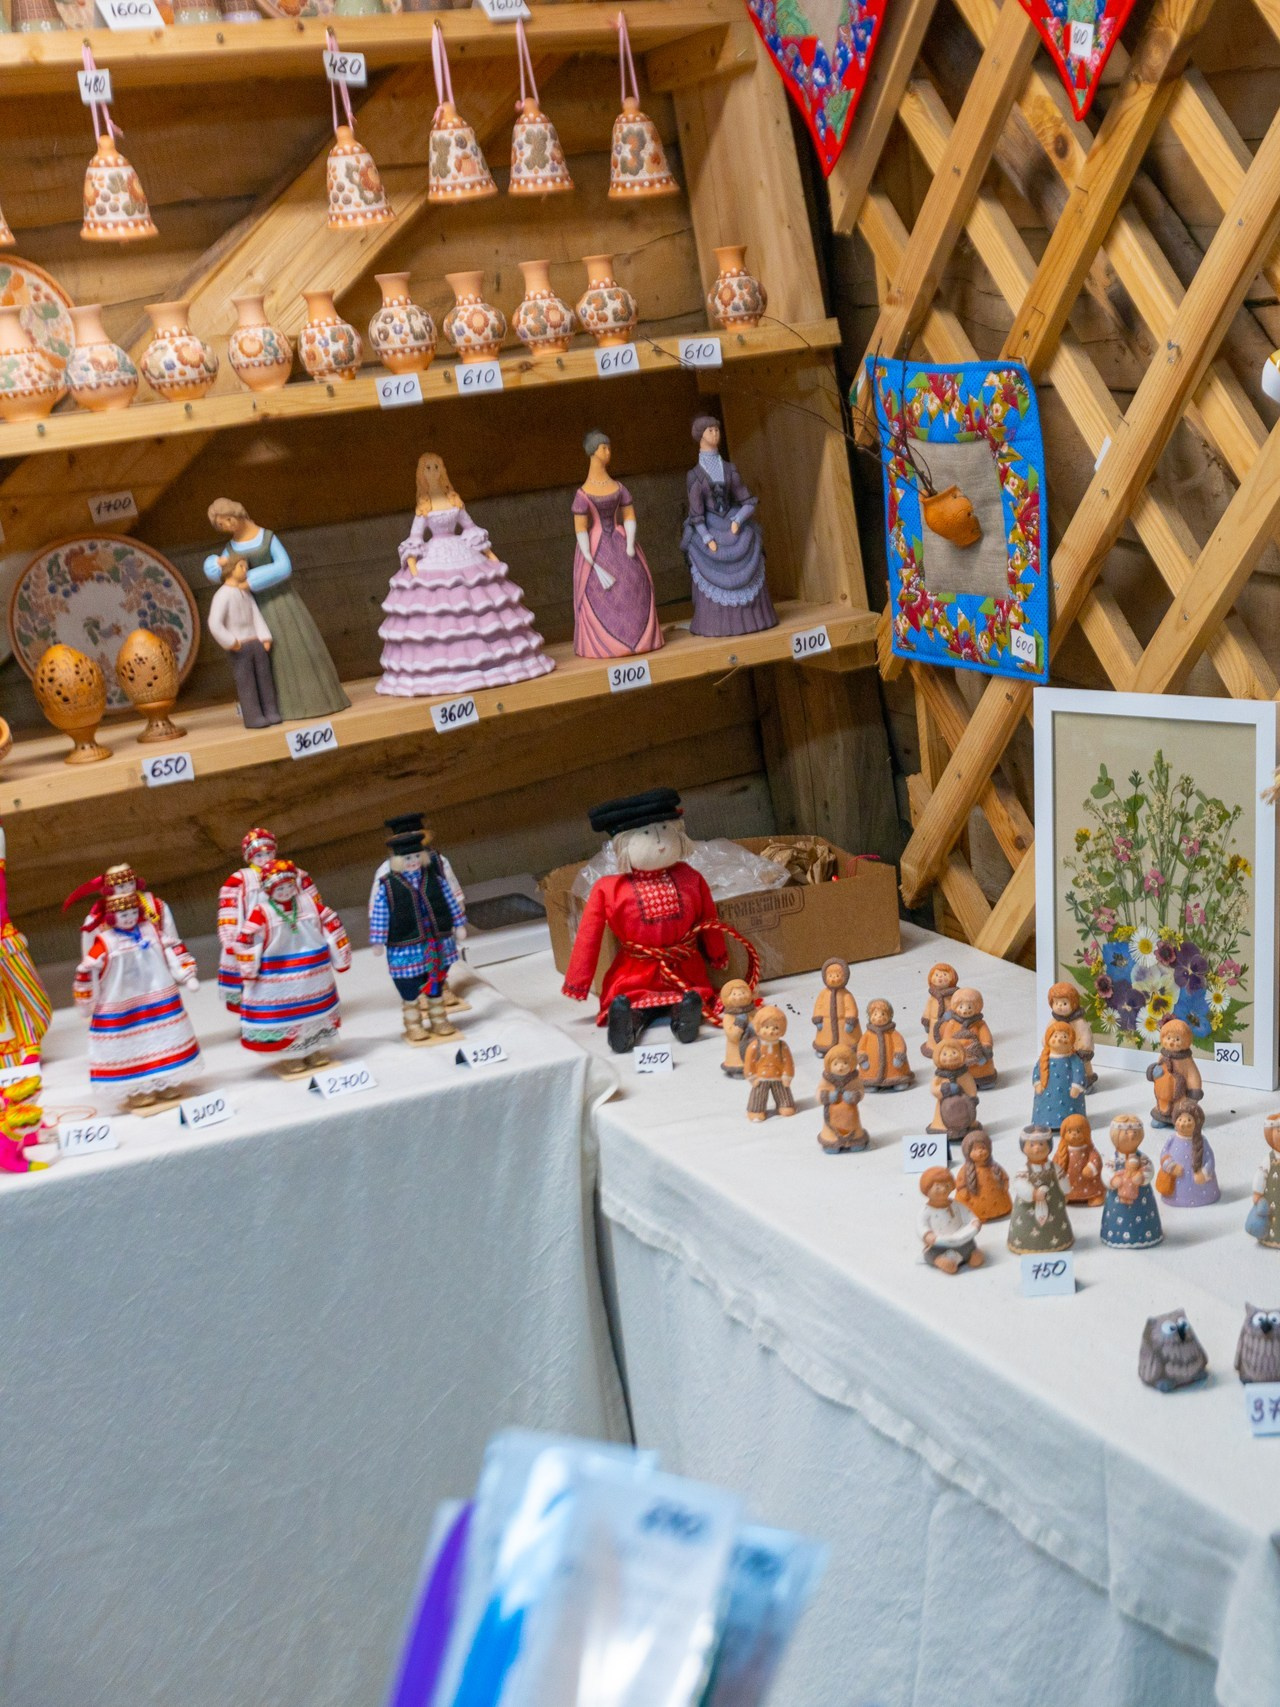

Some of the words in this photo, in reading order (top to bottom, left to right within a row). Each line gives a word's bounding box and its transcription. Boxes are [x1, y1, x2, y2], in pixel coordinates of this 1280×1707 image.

[111, 2, 152, 18] 1600
[329, 54, 361, 77] 480
[84, 75, 106, 94] 480
[600, 349, 633, 371] 610
[684, 343, 715, 359] 610
[463, 369, 495, 386] 610
[382, 380, 416, 398] 610
[96, 497, 131, 515] 1700
[794, 632, 826, 653] 3100
[1014, 640, 1035, 656] 600
[612, 666, 646, 687] 3100
[439, 701, 475, 725] 3600
[294, 727, 333, 752] 3600
[150, 756, 187, 778] 650
[638, 1051, 670, 1066] 2450
[1216, 1048, 1240, 1063] 580
[327, 1071, 369, 1094] 2700
[65, 1125, 110, 1146] 1760
[909, 1143, 938, 1160] 980
[1032, 1259, 1068, 1280] 750
